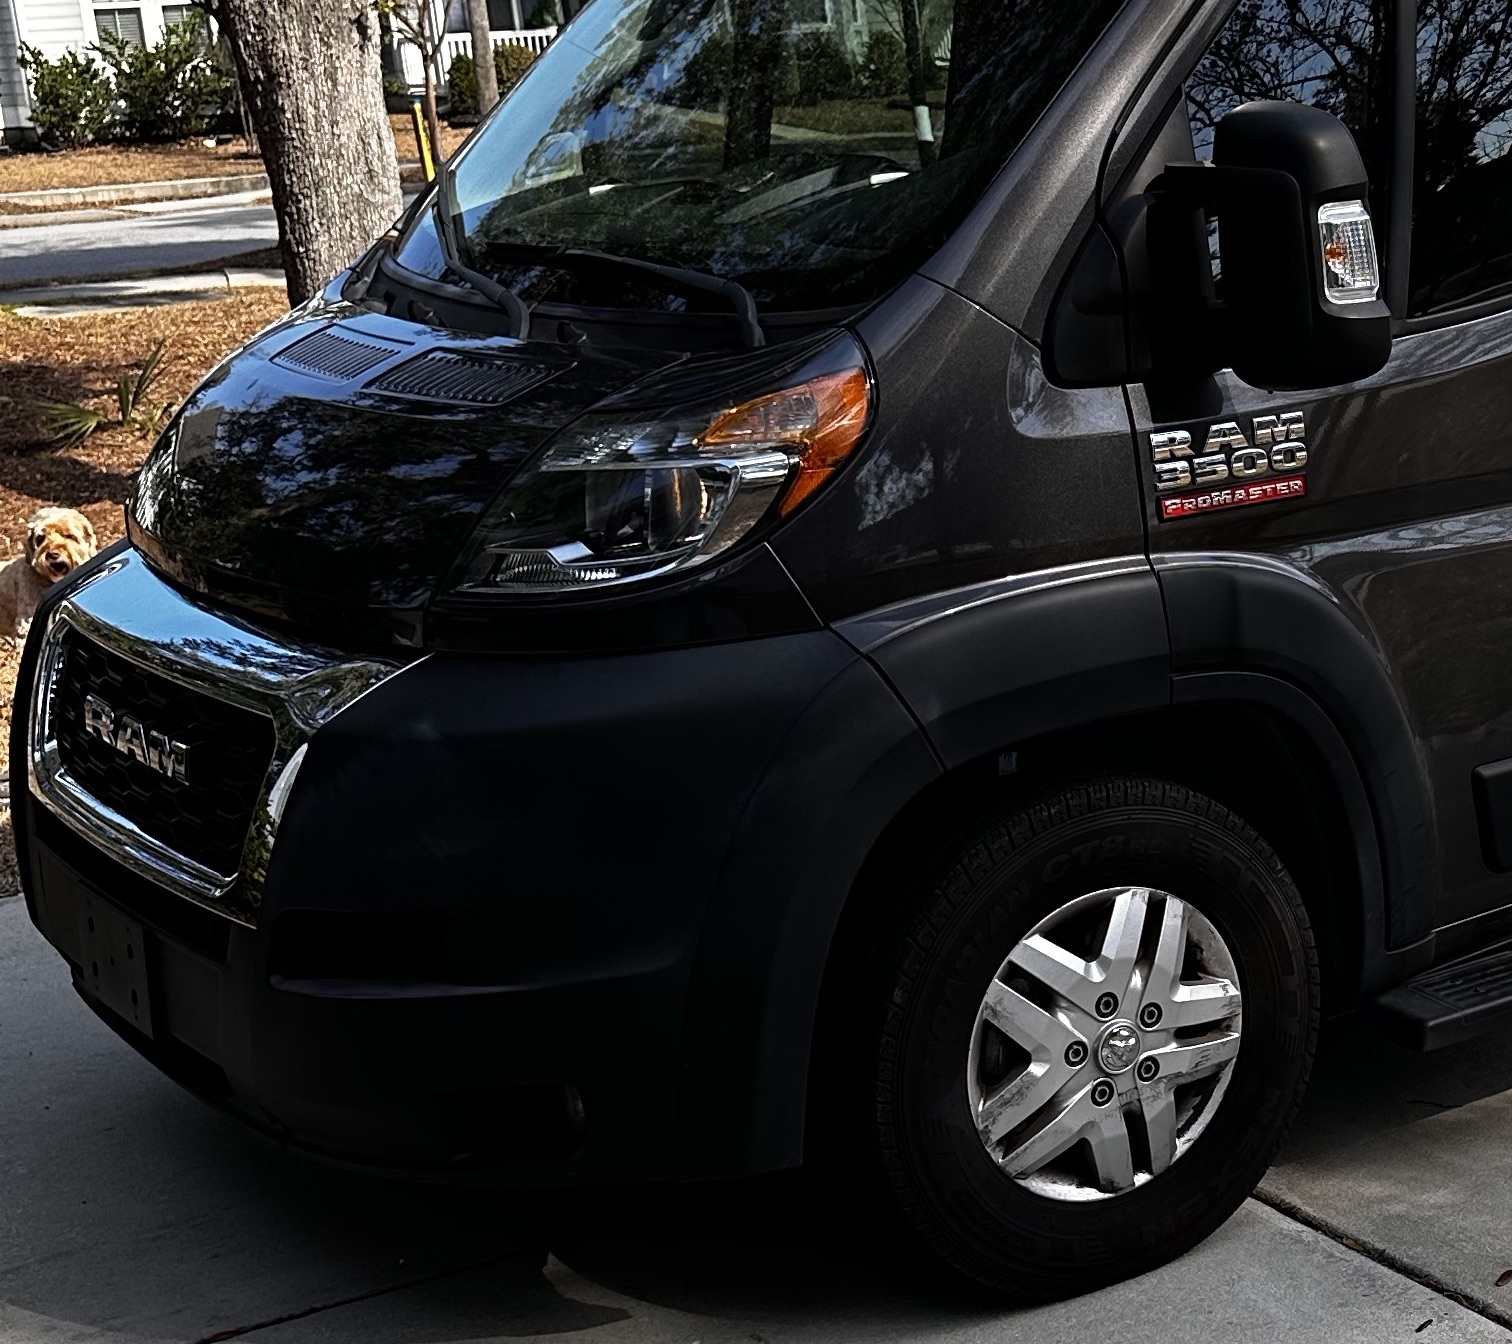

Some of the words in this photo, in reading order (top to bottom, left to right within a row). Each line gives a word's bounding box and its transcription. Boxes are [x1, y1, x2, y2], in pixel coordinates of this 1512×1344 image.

[1150, 411, 1305, 461] RAM
[1153, 441, 1308, 492] 3500
[1164, 480, 1303, 514] PROMASTER
[84, 693, 191, 786] RAM
